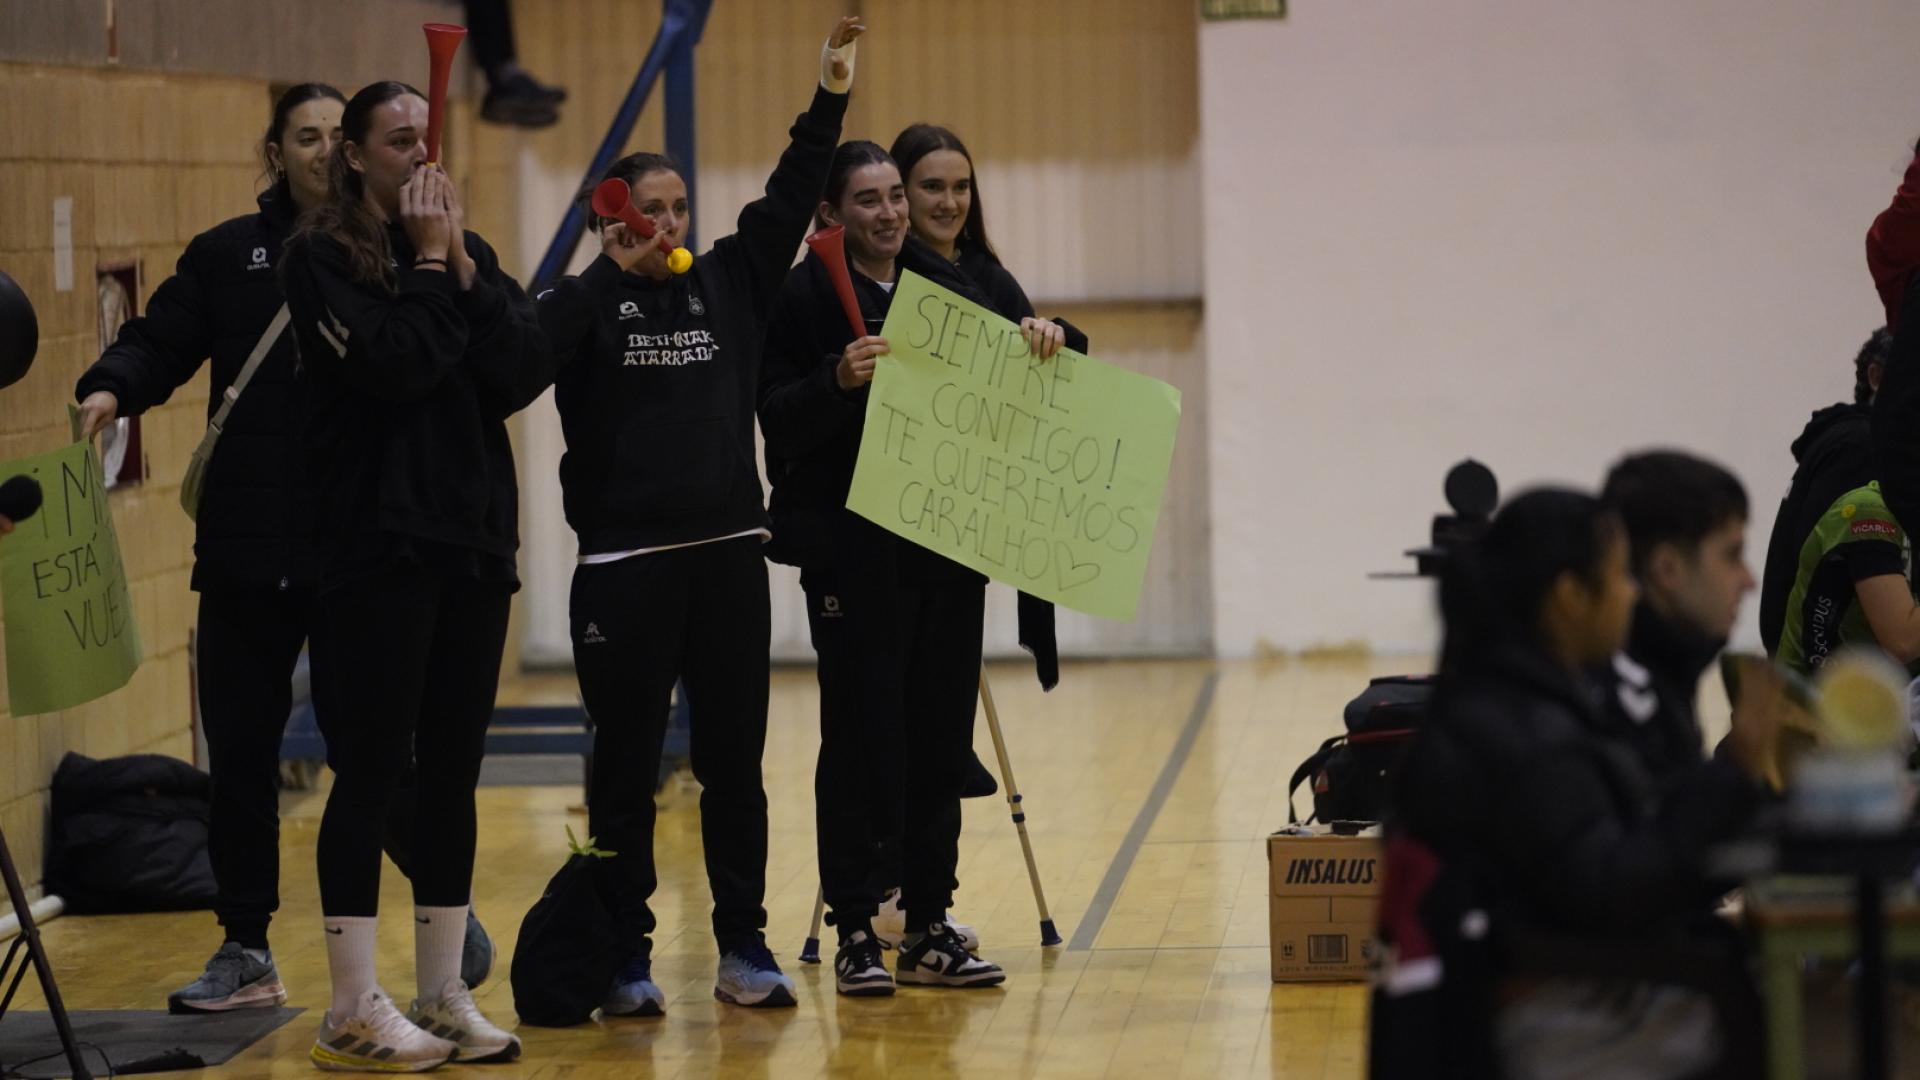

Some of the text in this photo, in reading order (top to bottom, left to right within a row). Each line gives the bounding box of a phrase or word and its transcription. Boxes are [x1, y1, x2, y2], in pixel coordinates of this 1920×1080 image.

[906, 294, 1076, 414] SIEMPRE
[881, 402, 1138, 553] TE QUEREMOS
[932, 383, 1121, 490] CONTIGO!
[899, 481, 1050, 580] CARALHO
[1285, 858, 1376, 884] INSALUS
